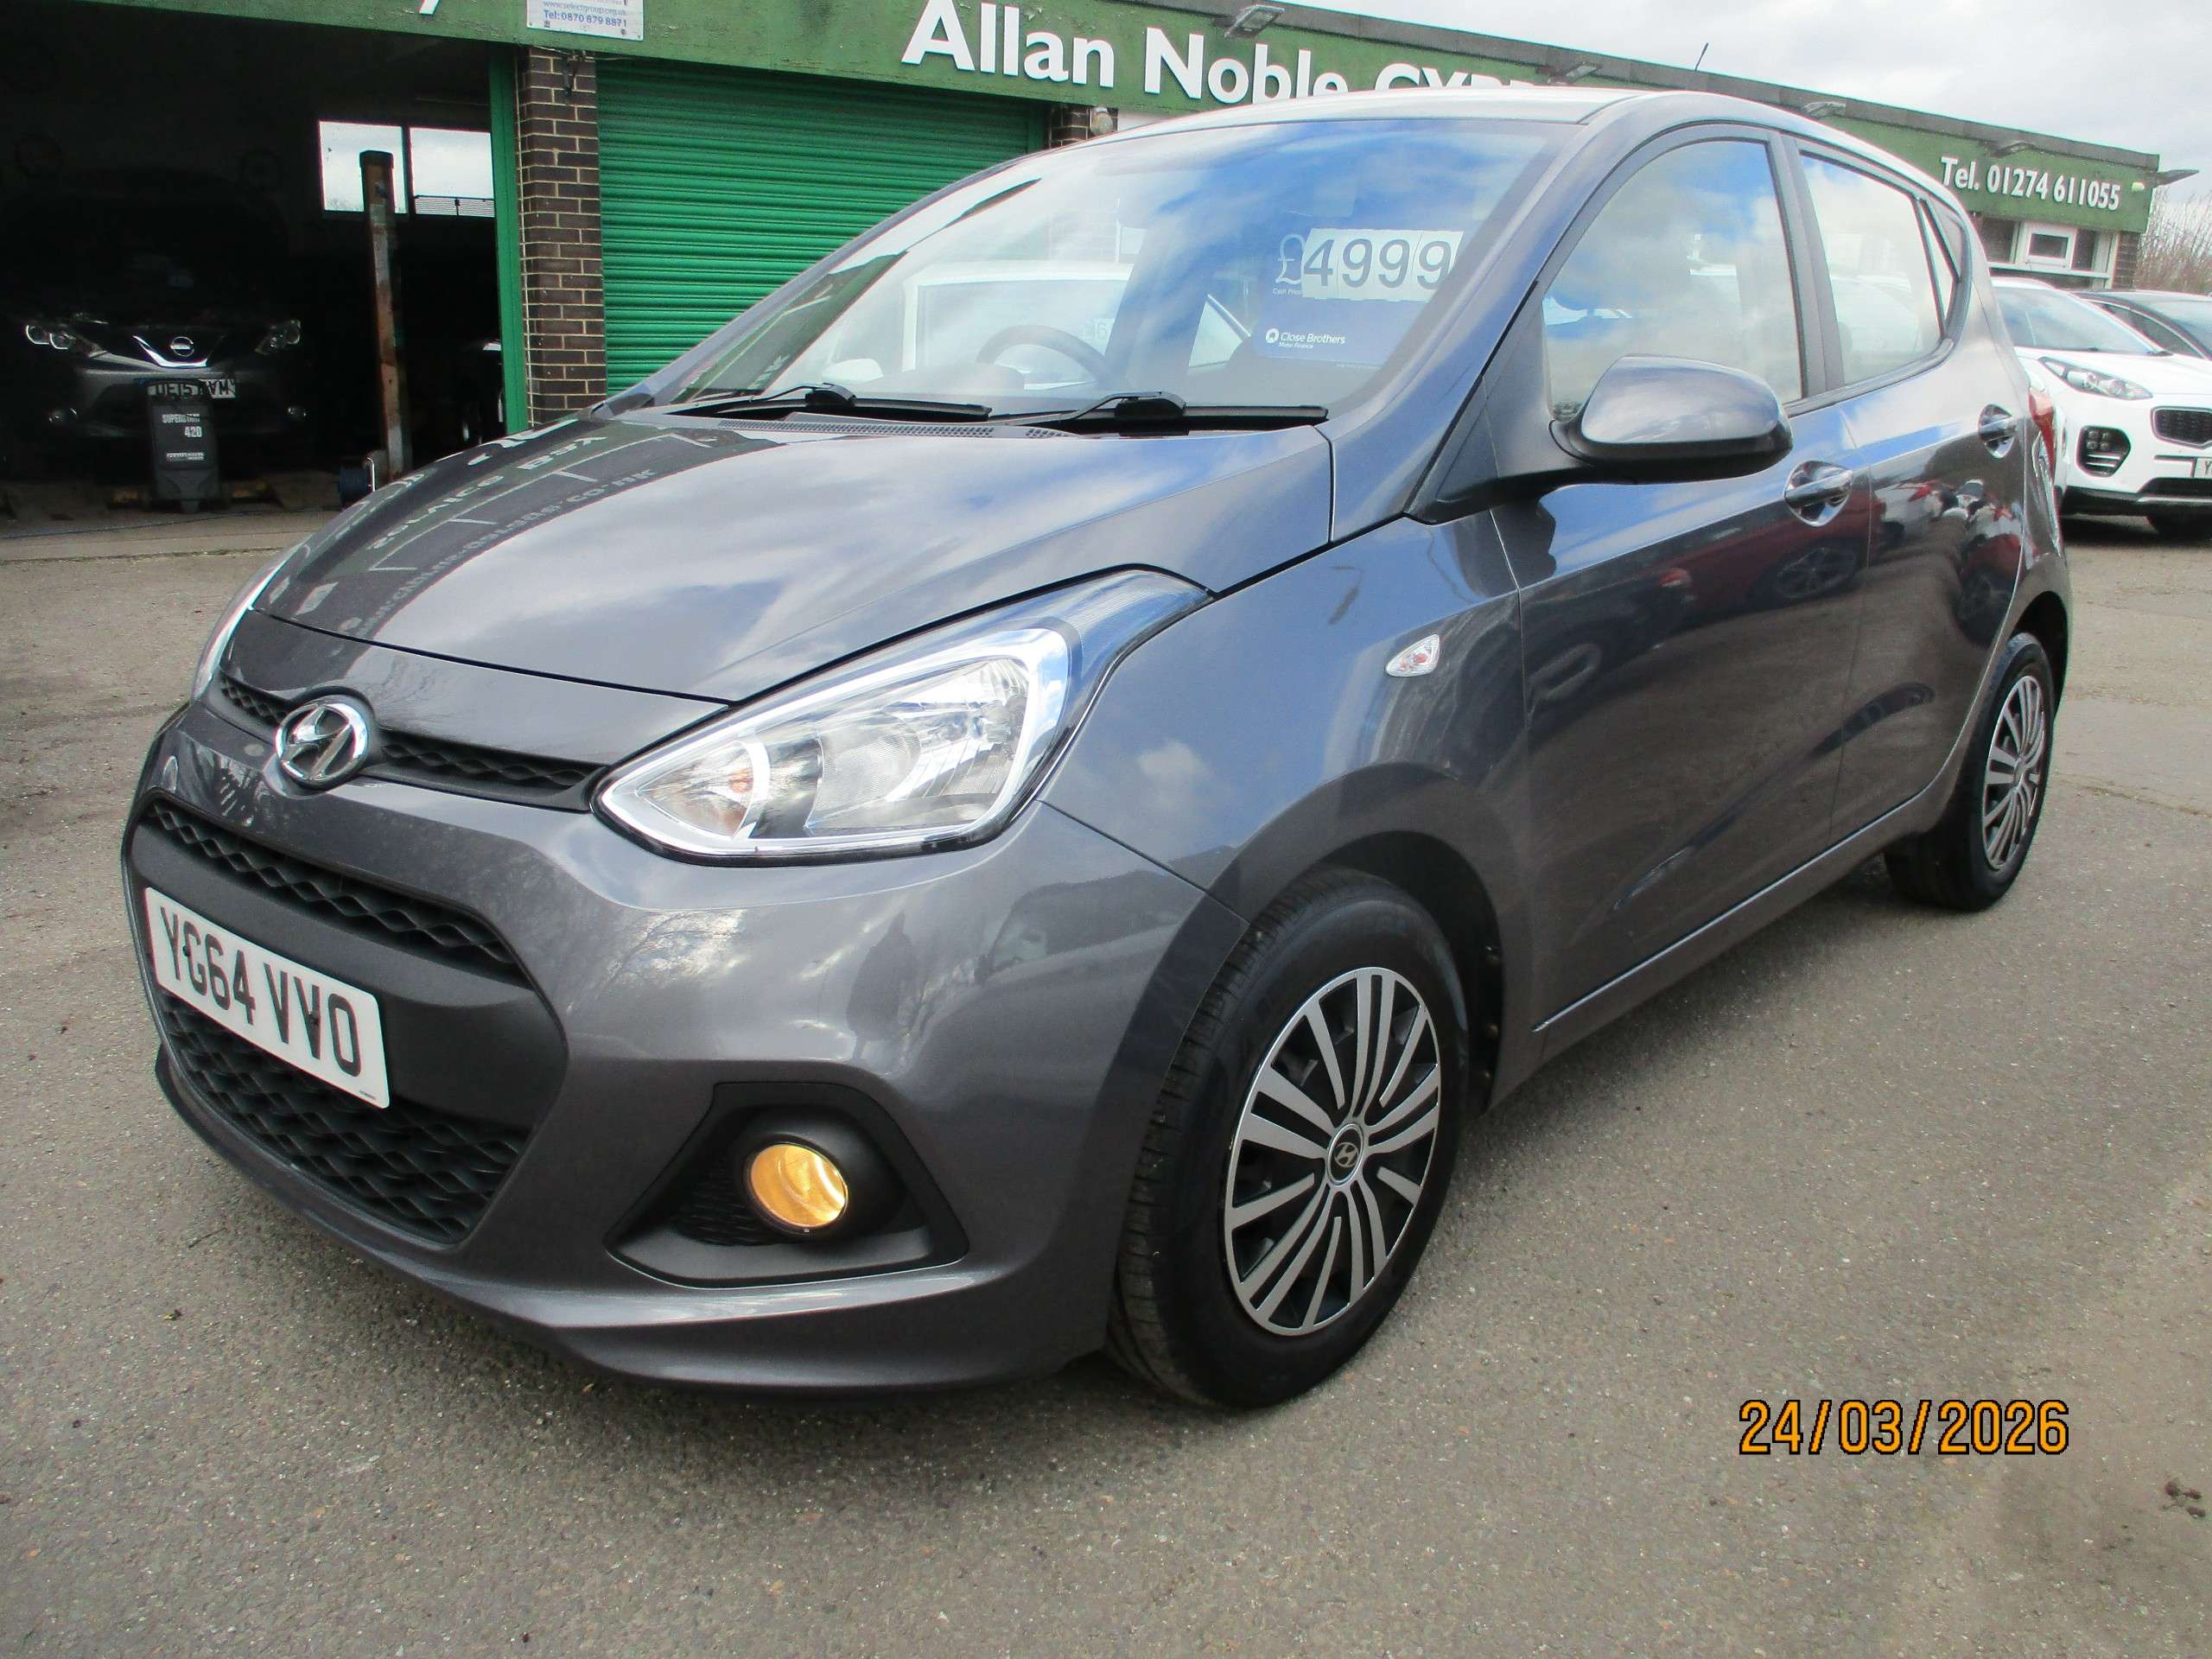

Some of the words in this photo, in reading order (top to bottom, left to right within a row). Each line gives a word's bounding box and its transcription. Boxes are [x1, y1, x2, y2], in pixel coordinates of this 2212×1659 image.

[562, 12, 584, 22] 0870
[587, 15, 604, 25] 879
[901, 0, 1115, 88] Allan
[1144, 27, 1349, 104] Noble
[1941, 156, 1980, 190] Tel.
[1987, 165, 2049, 200] 01274
[2054, 175, 2120, 210] 611055
[1281, 332, 1306, 342] Close
[1306, 333, 1346, 345] Brothers
[184, 426, 202, 437] 420
[160, 906, 257, 1026] YG64
